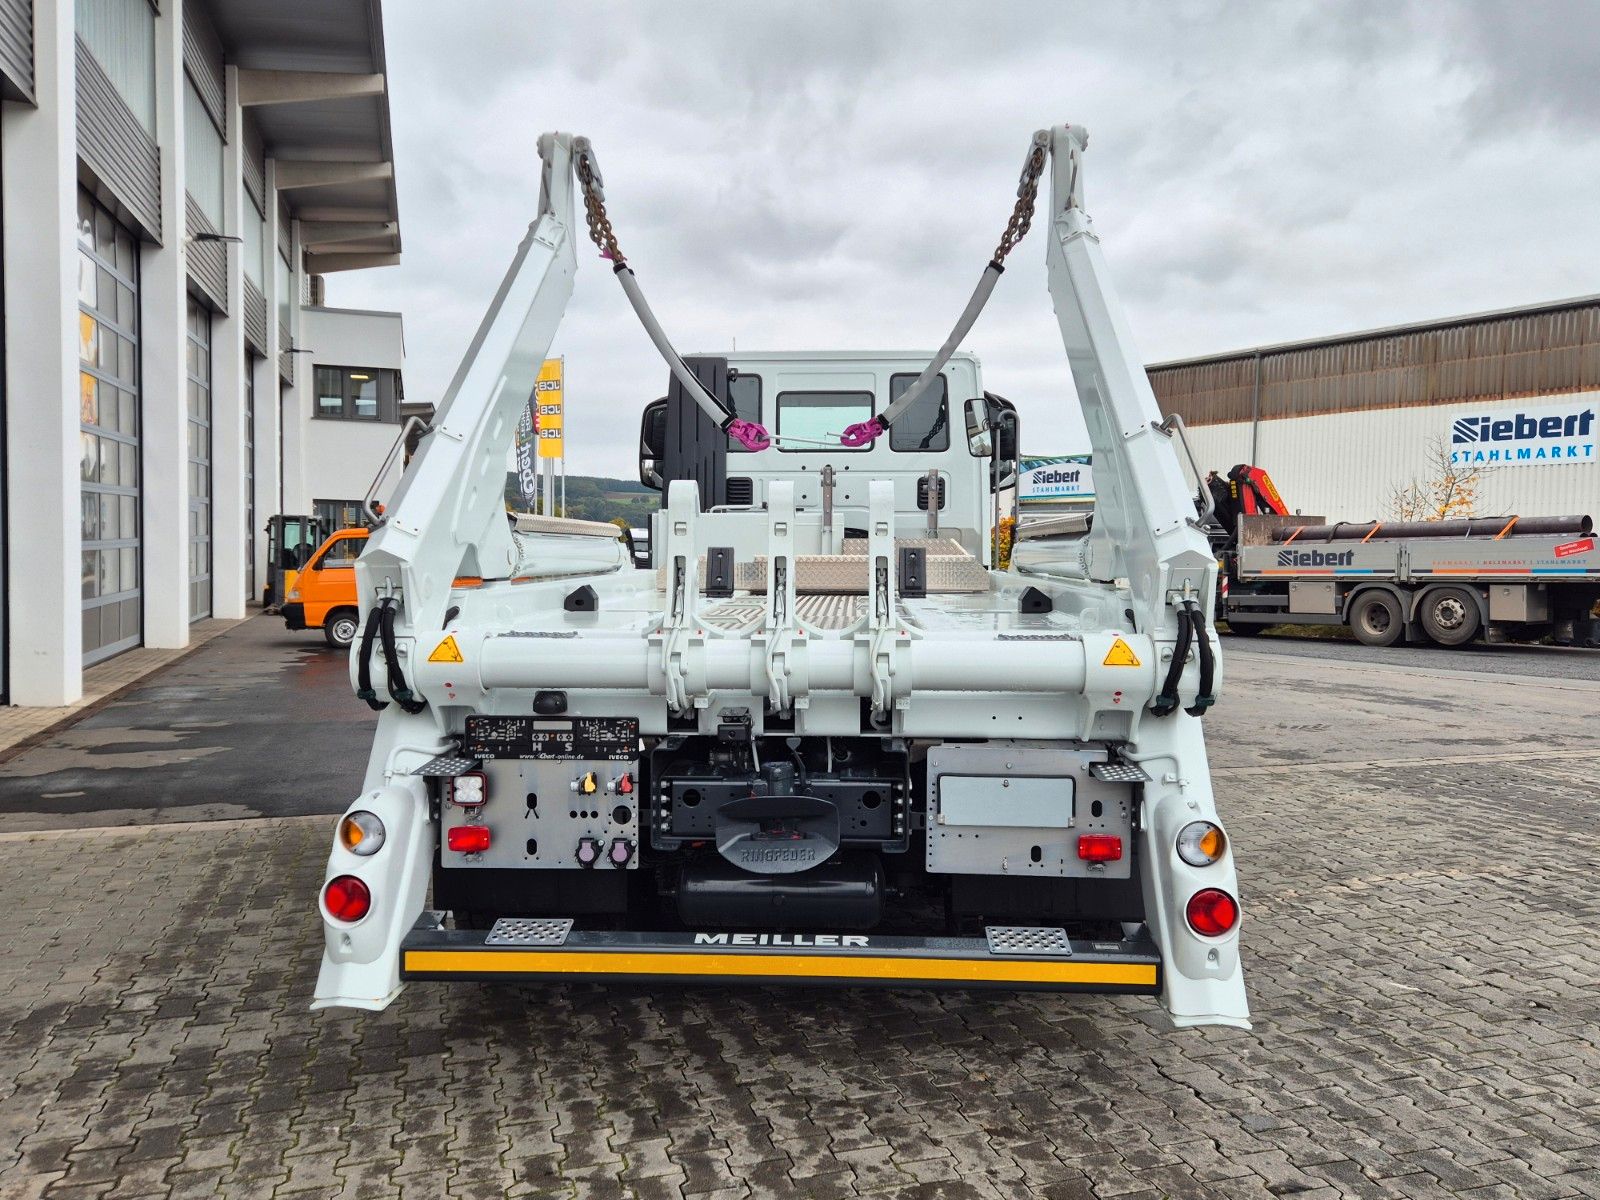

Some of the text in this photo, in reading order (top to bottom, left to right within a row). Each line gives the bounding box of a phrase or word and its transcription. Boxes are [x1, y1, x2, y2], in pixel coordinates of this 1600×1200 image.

[1453, 409, 1595, 444] Siebert
[1451, 445, 1593, 463] STAHLMARKT
[1033, 469, 1081, 484] Siebert
[1032, 485, 1080, 493] STAHLMARKT
[1278, 550, 1354, 566] Siebert
[740, 848, 816, 862] RINGFEDER
[694, 933, 869, 947] MEILLER
